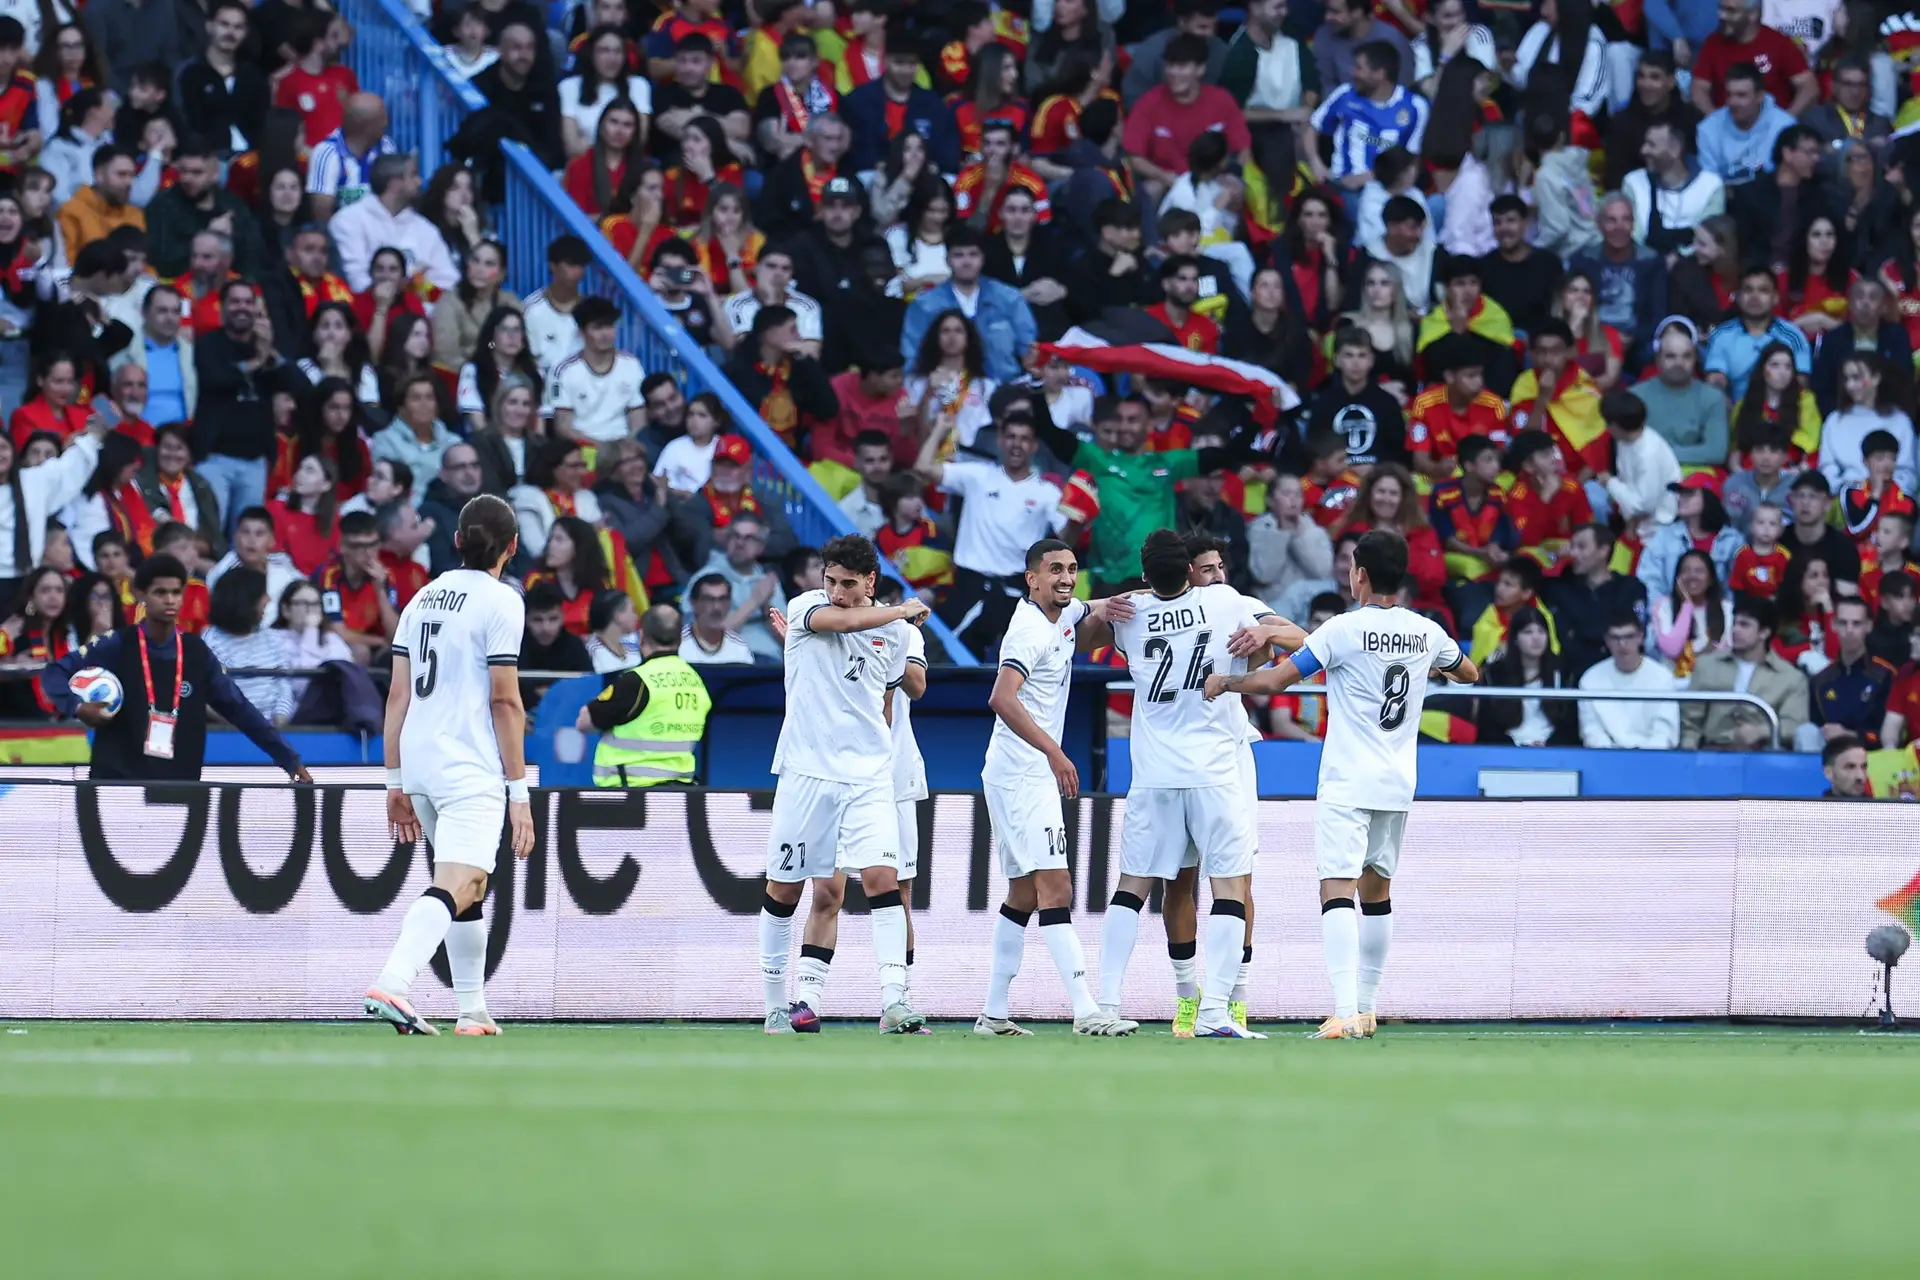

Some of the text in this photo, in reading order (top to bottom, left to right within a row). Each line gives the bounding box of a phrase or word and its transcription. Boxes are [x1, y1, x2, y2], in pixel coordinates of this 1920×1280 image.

[417, 589, 467, 612] AKAM
[1363, 631, 1428, 653] IBRAHIM
[415, 621, 443, 700] 5
[1143, 630, 1214, 704] 24
[649, 671, 703, 688] SEGURID
[1379, 662, 1409, 732] 8
[1045, 827, 1065, 855] 16
[780, 842, 806, 871] 21
[1073, 970, 1085, 979] JAK
